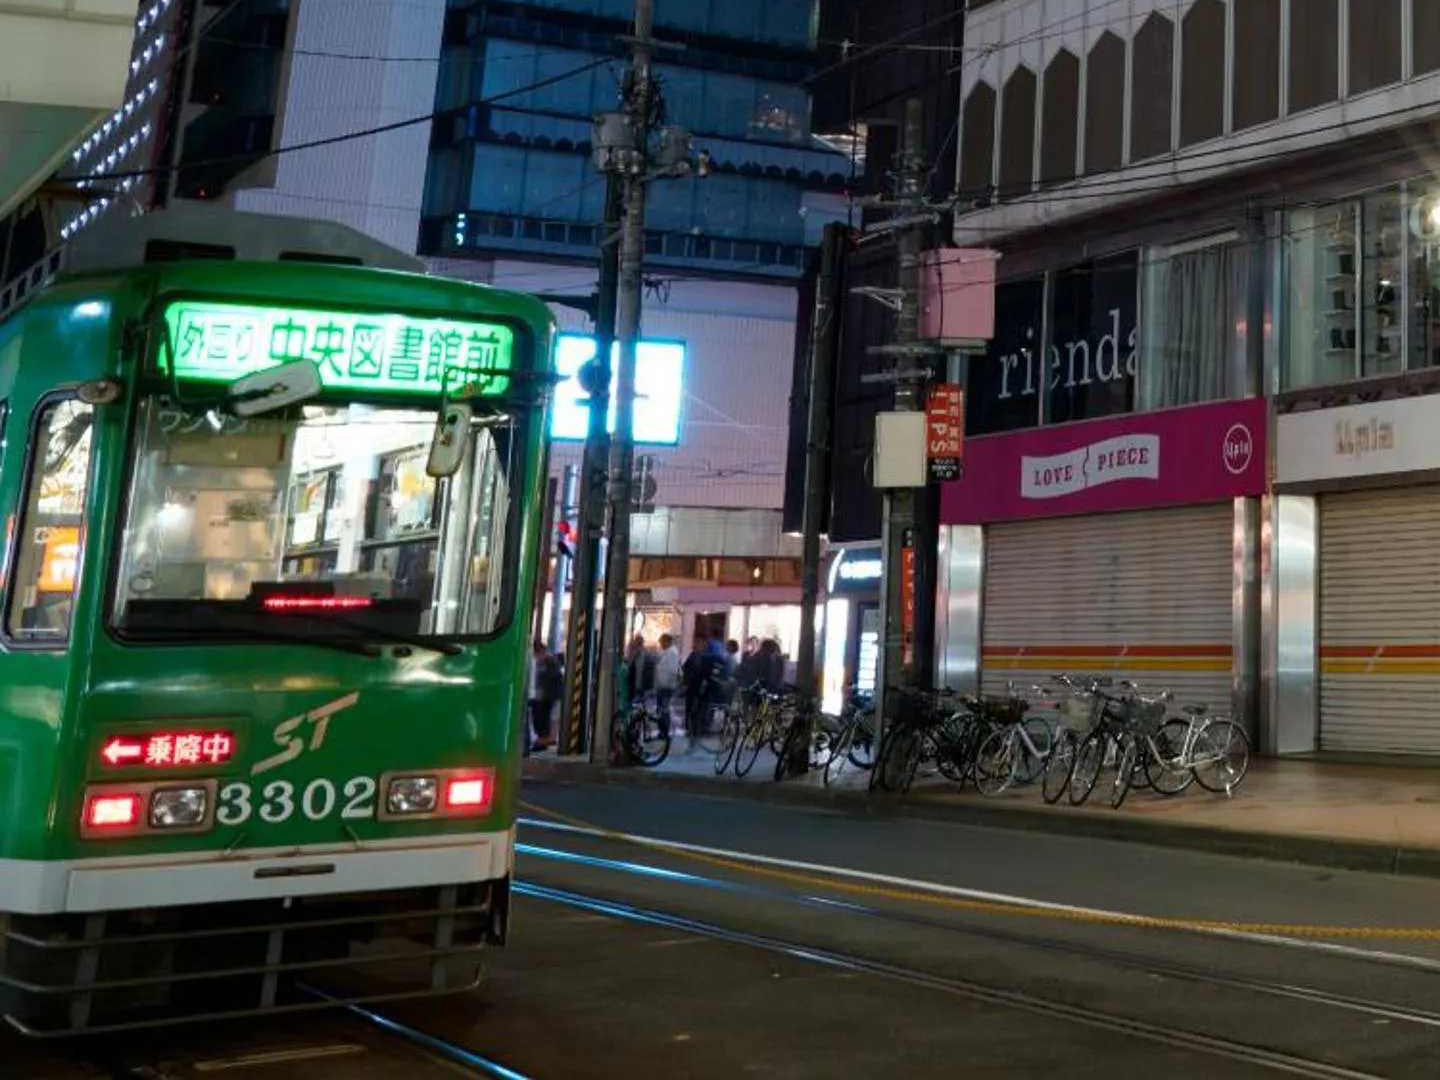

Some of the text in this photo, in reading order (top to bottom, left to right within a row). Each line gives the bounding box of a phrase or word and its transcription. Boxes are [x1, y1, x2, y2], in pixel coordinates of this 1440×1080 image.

[269, 318, 501, 386] 中央図書館前
[1033, 447, 1149, 486] LOVE PIECE
[145, 734, 231, 764] 乗降中
[250, 691, 360, 776] ST
[216, 776, 377, 826] 3302
